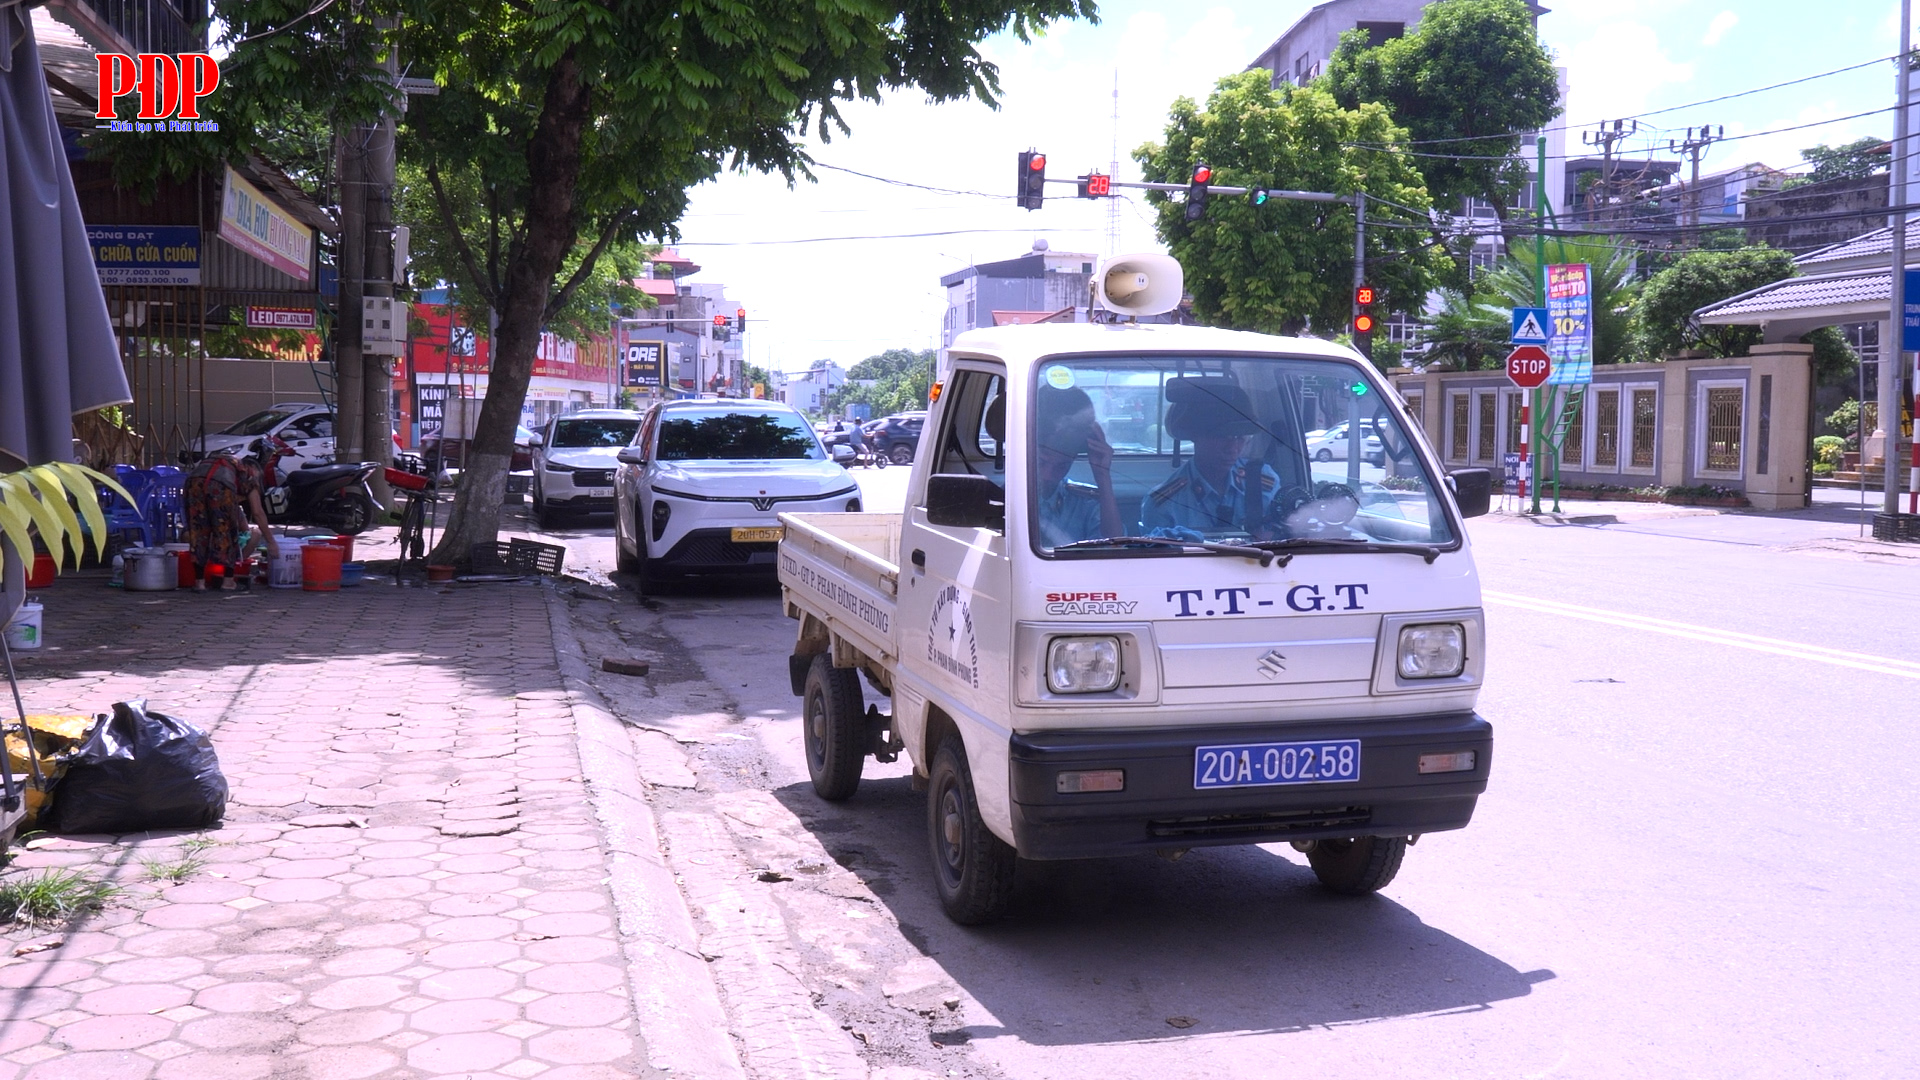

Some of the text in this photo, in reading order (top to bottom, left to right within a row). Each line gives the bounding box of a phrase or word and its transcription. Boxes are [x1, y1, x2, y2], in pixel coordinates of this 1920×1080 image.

[1089, 176, 1109, 195] 28
[236, 188, 252, 232] BIA
[127, 232, 154, 240] ĐẠT
[100, 243, 133, 262] CHỮA
[136, 241, 161, 262] CỬA
[164, 241, 197, 262] CUỐN
[1359, 289, 1371, 303] 28
[251, 310, 273, 324] LED
[1511, 359, 1547, 374] STOP
[782, 553, 798, 577] TTXD
[817, 574, 837, 600] PHAN
[838, 583, 858, 617] ĐÌNH
[859, 599, 889, 633] PHÙNG
[1046, 592, 1117, 601] SUPER
[1045, 601, 1138, 616] CARRY
[1200, 745, 1354, 783] 20A-002.58
